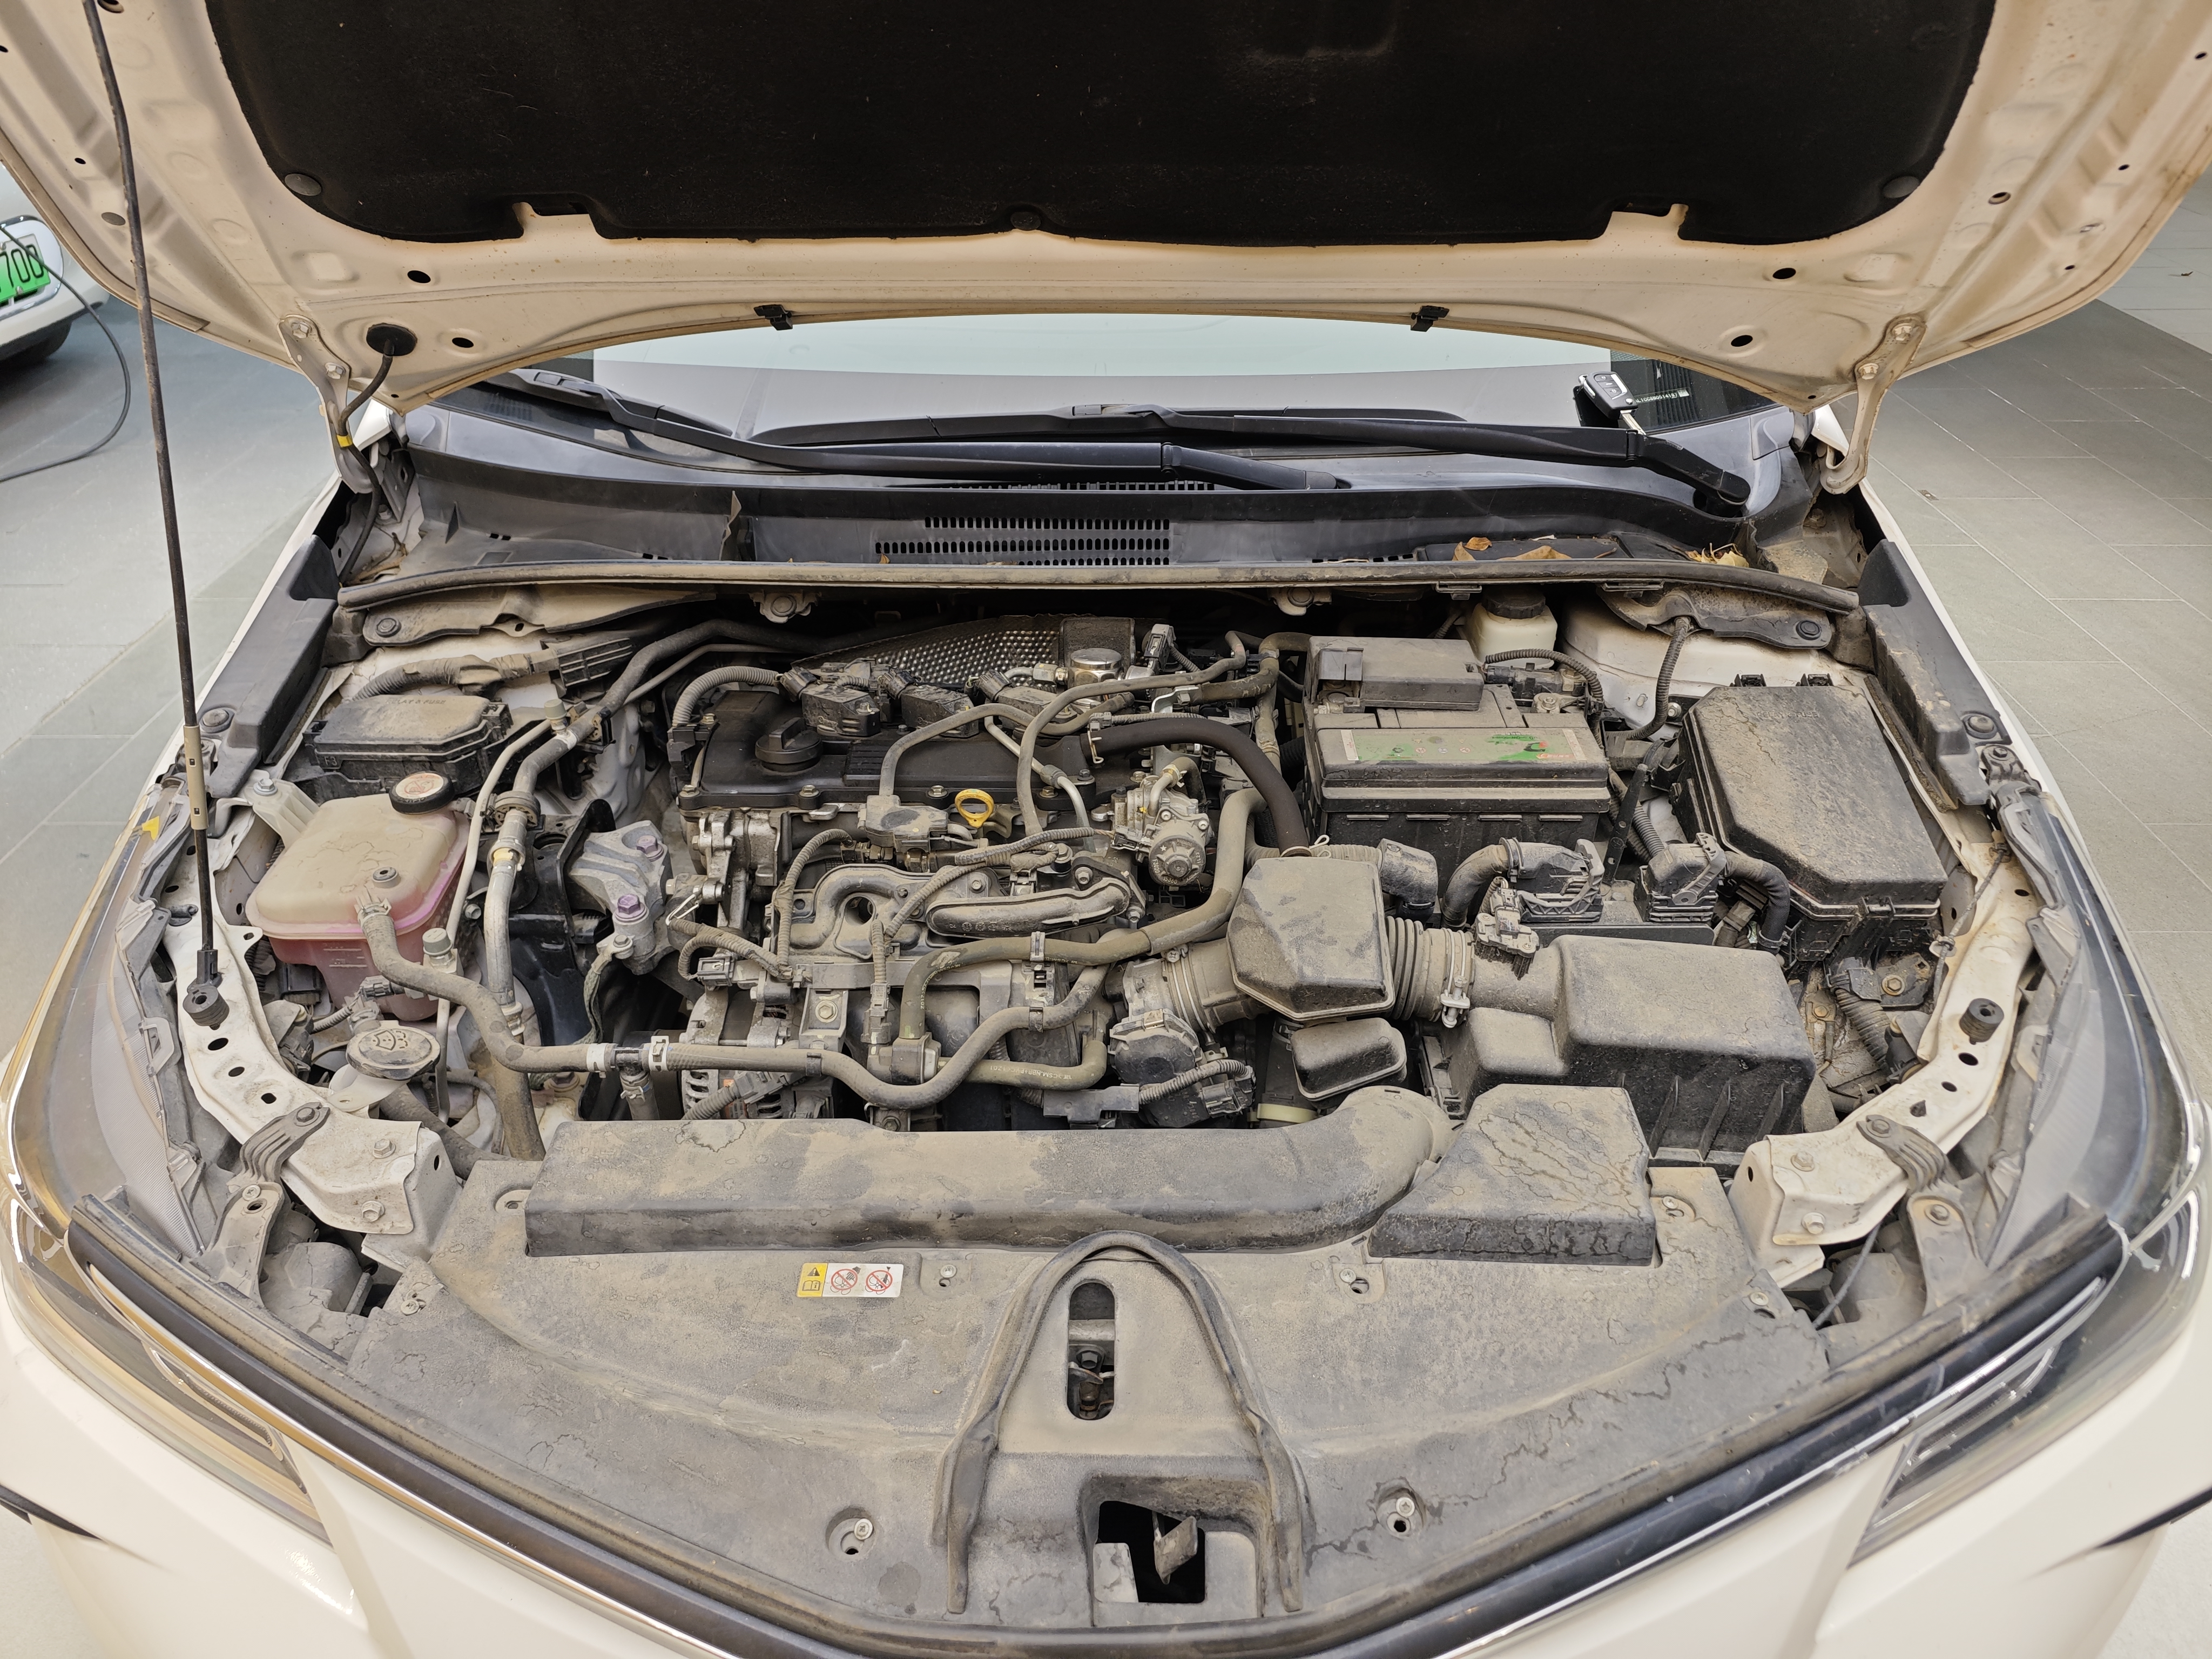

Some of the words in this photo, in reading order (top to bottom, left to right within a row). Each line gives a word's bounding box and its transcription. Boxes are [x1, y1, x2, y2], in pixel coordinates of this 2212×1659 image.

[324, 756, 337, 766] F3
[1152, 859, 1161, 873] F3020
[1163, 876, 1178, 884] 15360
